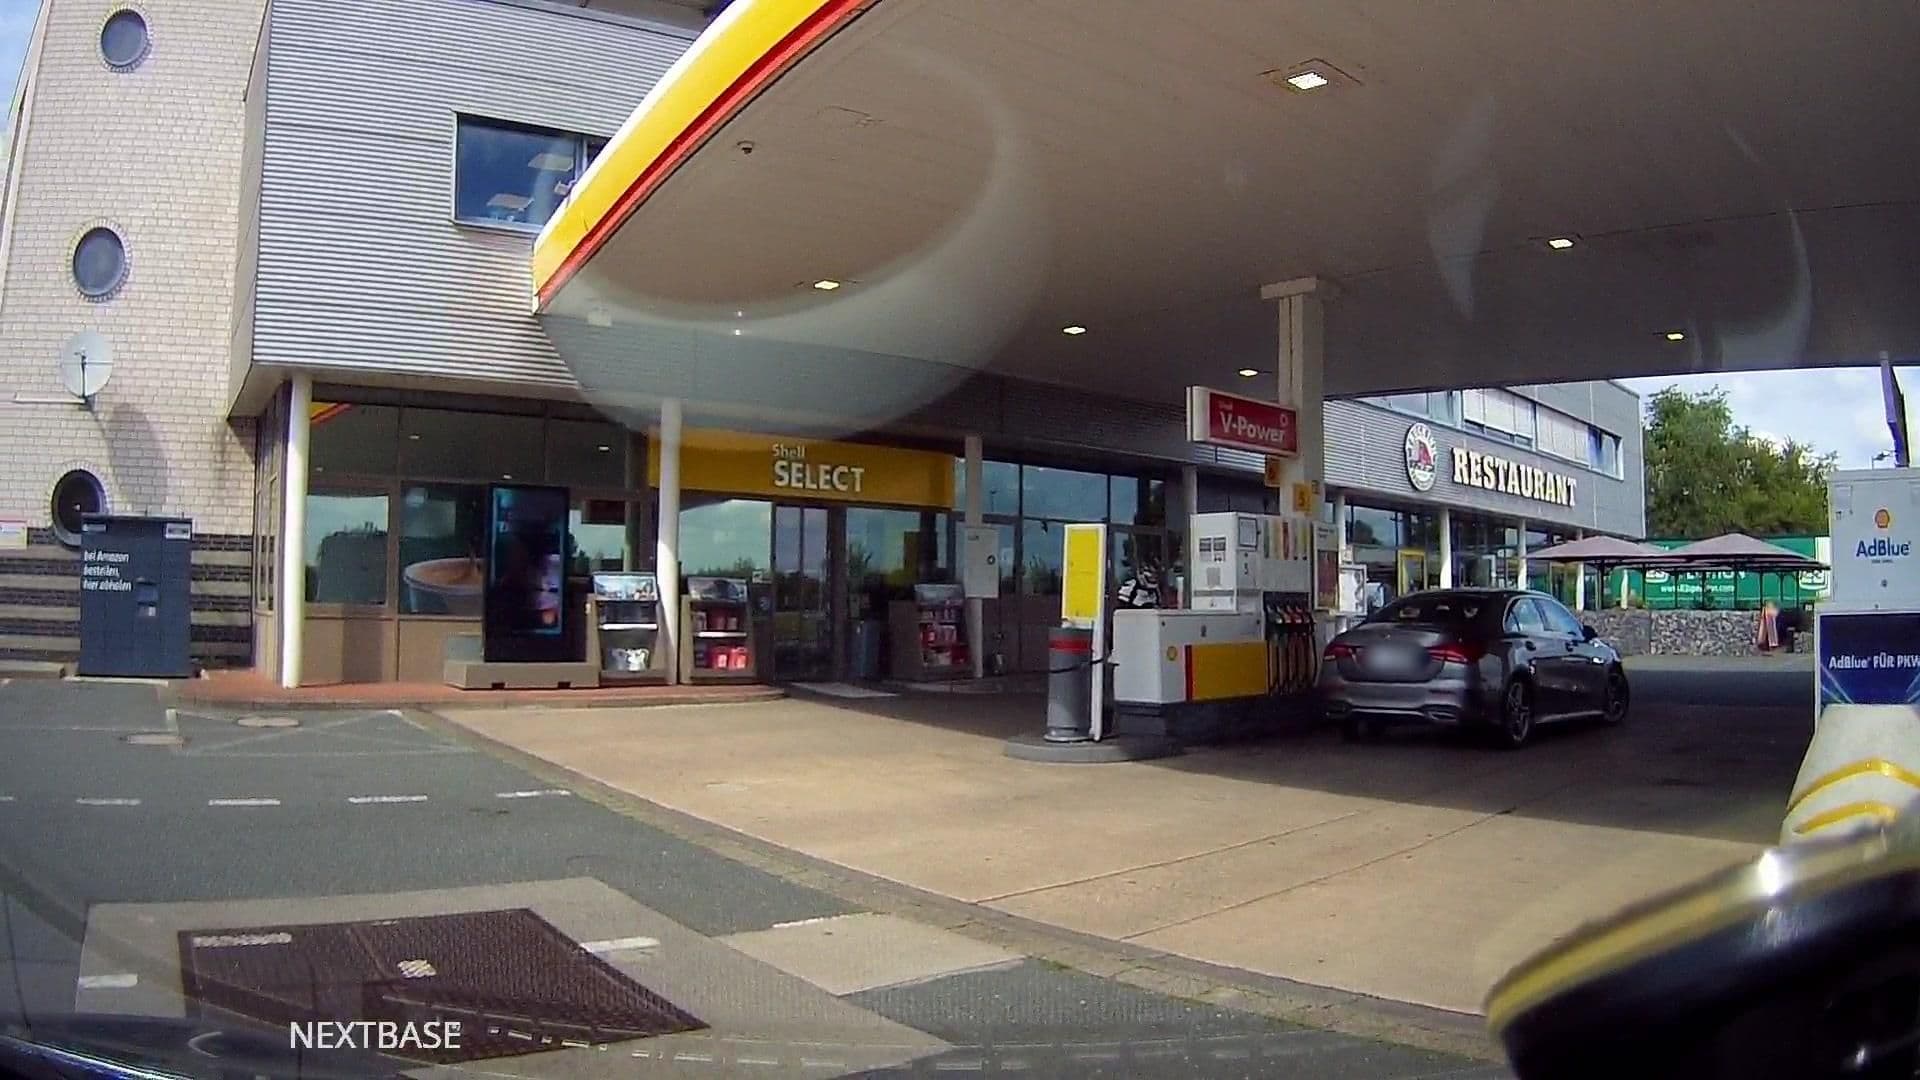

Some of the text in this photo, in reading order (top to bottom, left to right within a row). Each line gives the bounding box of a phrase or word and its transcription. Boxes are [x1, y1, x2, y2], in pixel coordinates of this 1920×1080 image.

[1220, 411, 1286, 443] V-Power
[772, 443, 805, 457] Shell
[774, 460, 865, 492] SELECT
[1452, 447, 1577, 506] RESTAURANT
[97, 550, 130, 563] Amazon
[1873, 651, 1895, 669] FÜR
